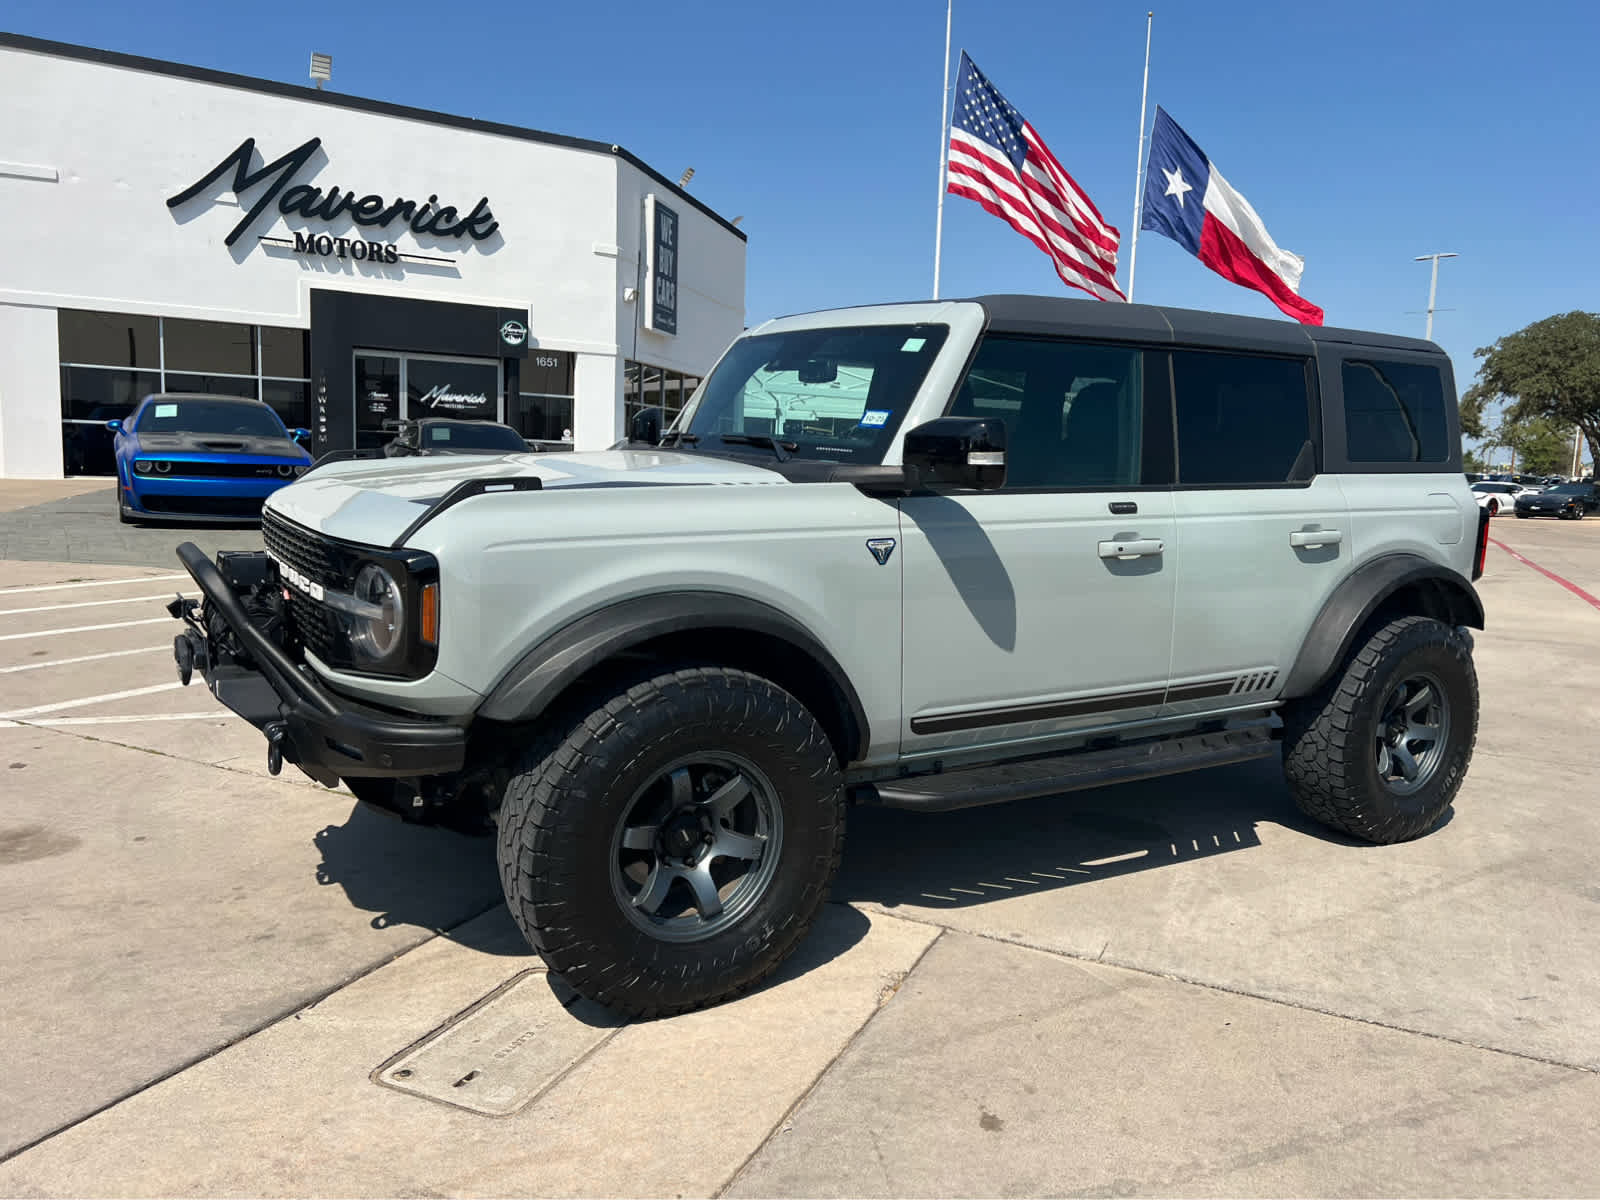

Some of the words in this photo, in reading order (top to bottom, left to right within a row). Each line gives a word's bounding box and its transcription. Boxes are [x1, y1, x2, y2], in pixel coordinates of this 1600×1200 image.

[166, 137, 499, 247] Maverick
[660, 212, 673, 246] WE
[293, 232, 398, 264] MOTORS
[659, 245, 674, 277] BUY
[656, 276, 676, 311] CARS
[536, 356, 558, 367] 1651
[420, 384, 487, 409] Maverick
[264, 547, 324, 600] ONCO
